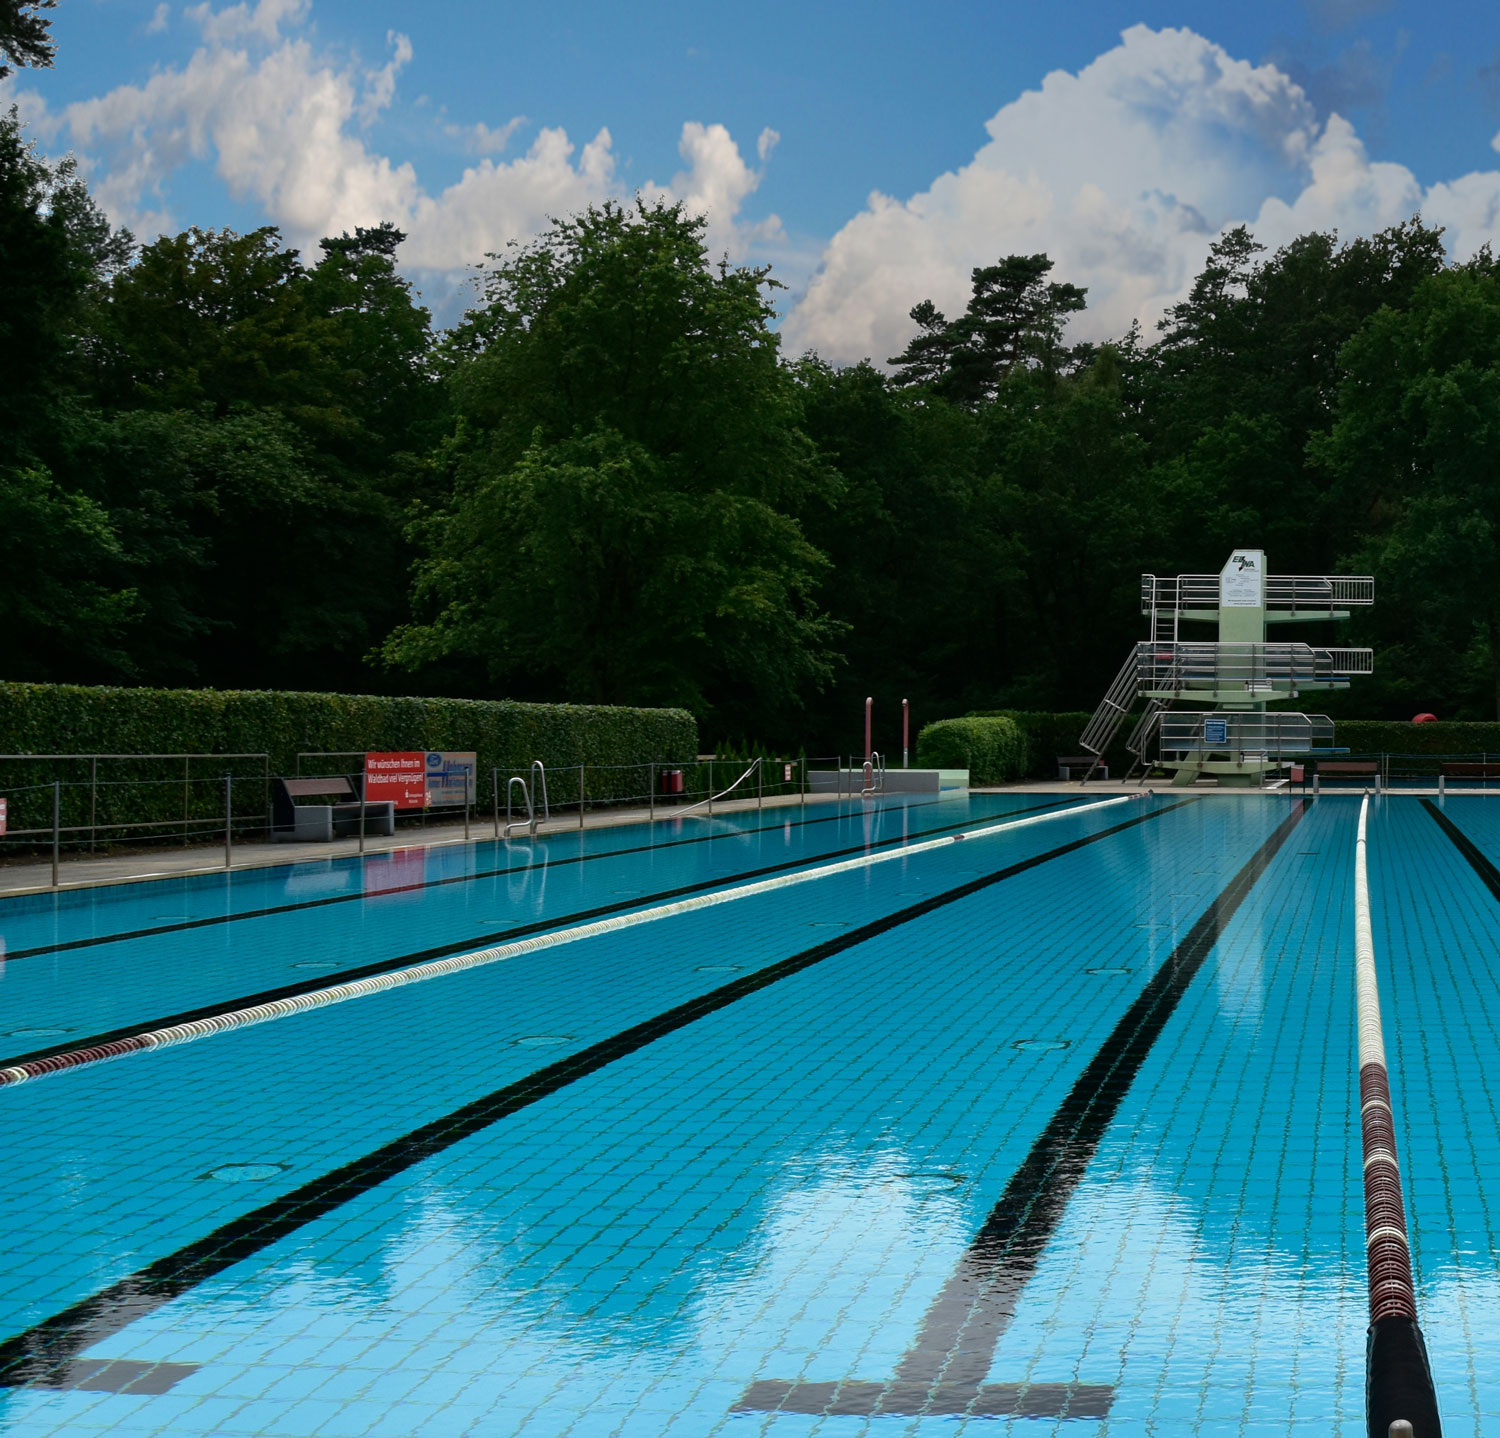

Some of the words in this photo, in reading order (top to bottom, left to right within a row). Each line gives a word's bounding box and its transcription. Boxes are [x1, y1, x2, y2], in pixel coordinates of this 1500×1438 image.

[368, 759, 377, 769] Wir
[377, 759, 400, 769] wünschen
[401, 759, 413, 768] Ihnen
[414, 759, 420, 768] im
[368, 773, 388, 783] Waldbad
[389, 773, 397, 783] viel
[398, 773, 423, 785] Vergnügen!
